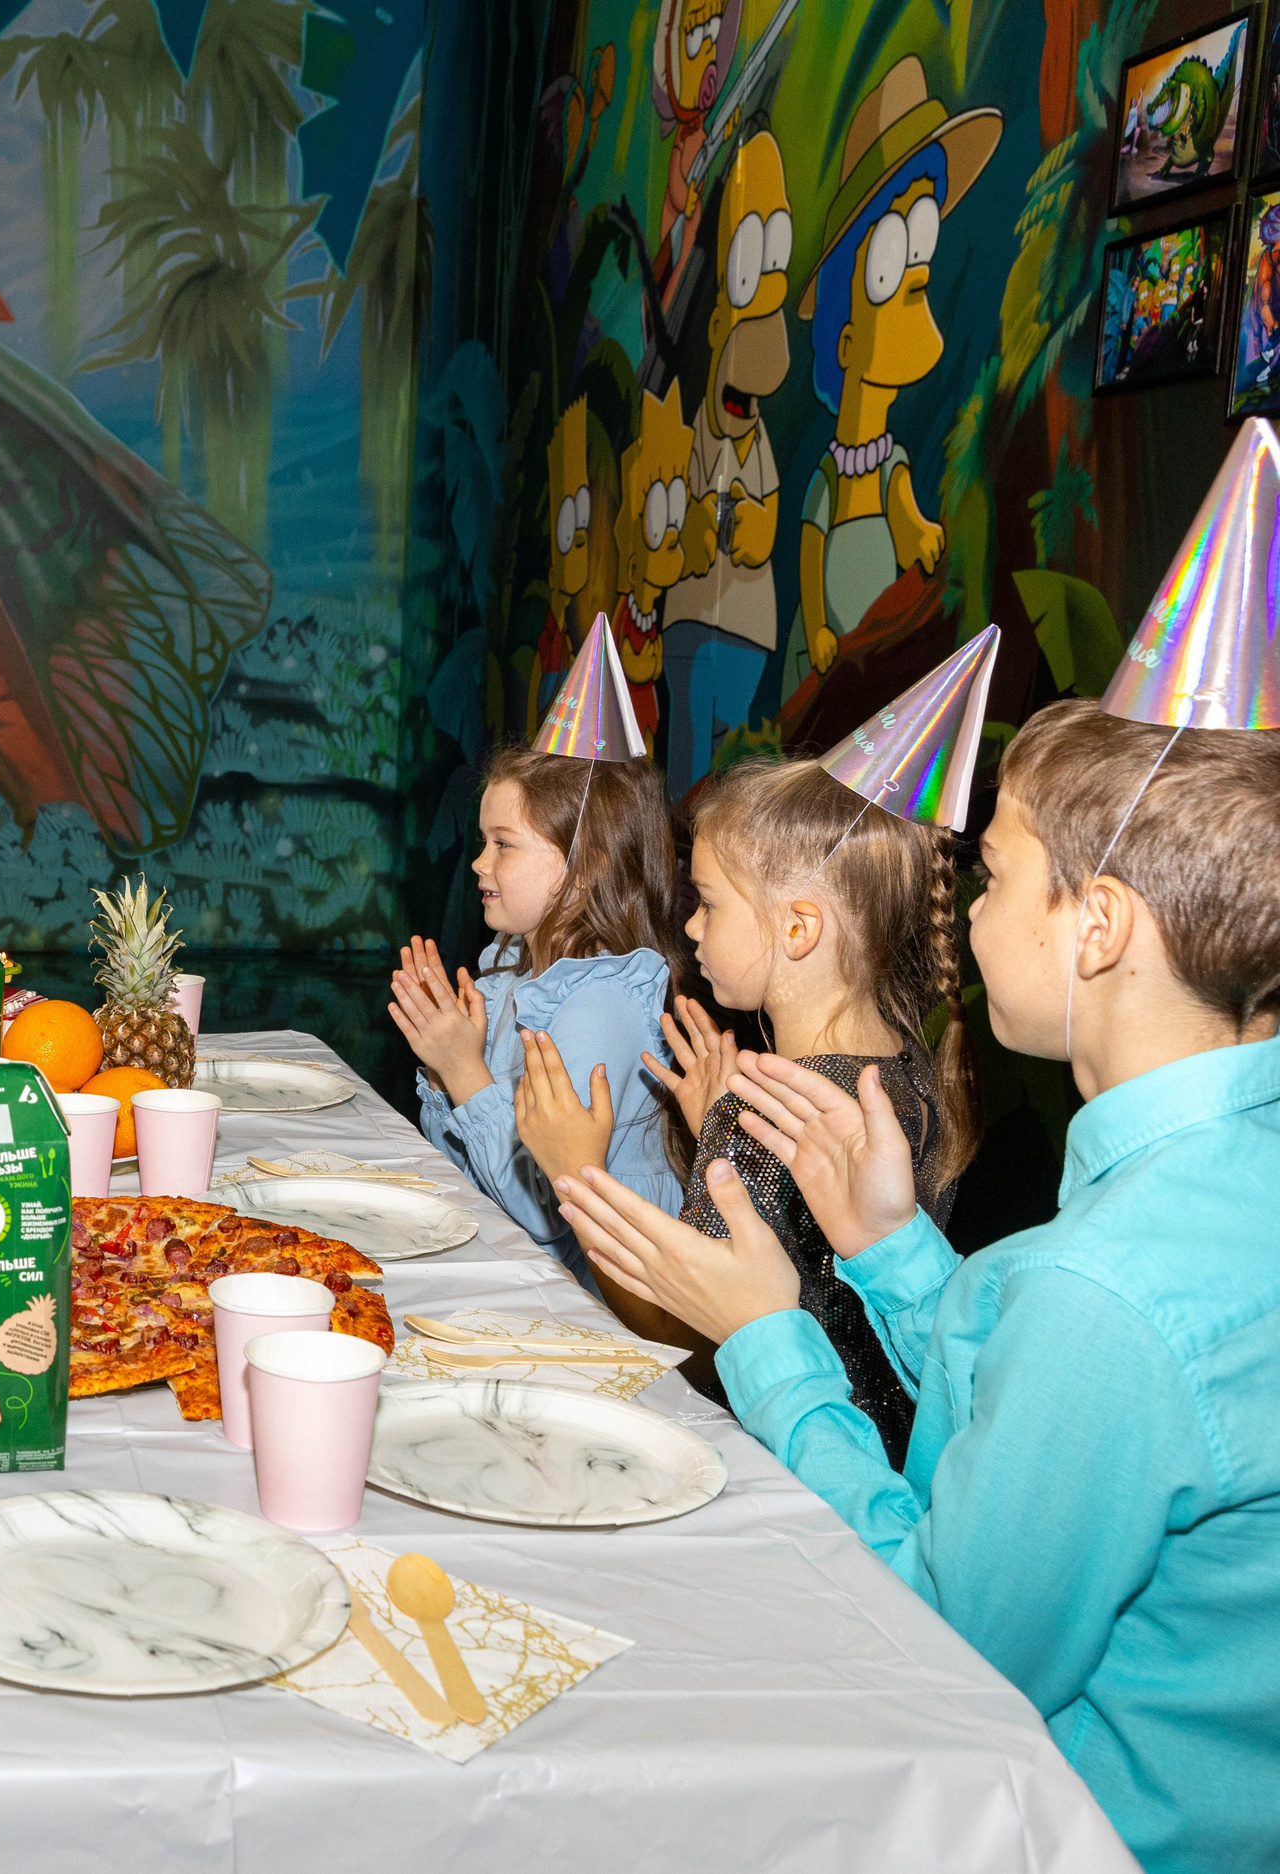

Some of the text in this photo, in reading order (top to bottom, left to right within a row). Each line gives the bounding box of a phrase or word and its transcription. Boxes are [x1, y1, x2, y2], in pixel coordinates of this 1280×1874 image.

[0, 1173, 34, 1182] КАЖДОГО
[9, 1181, 38, 1189] УЖИНА
[18, 1271, 43, 1281] СИЛ
